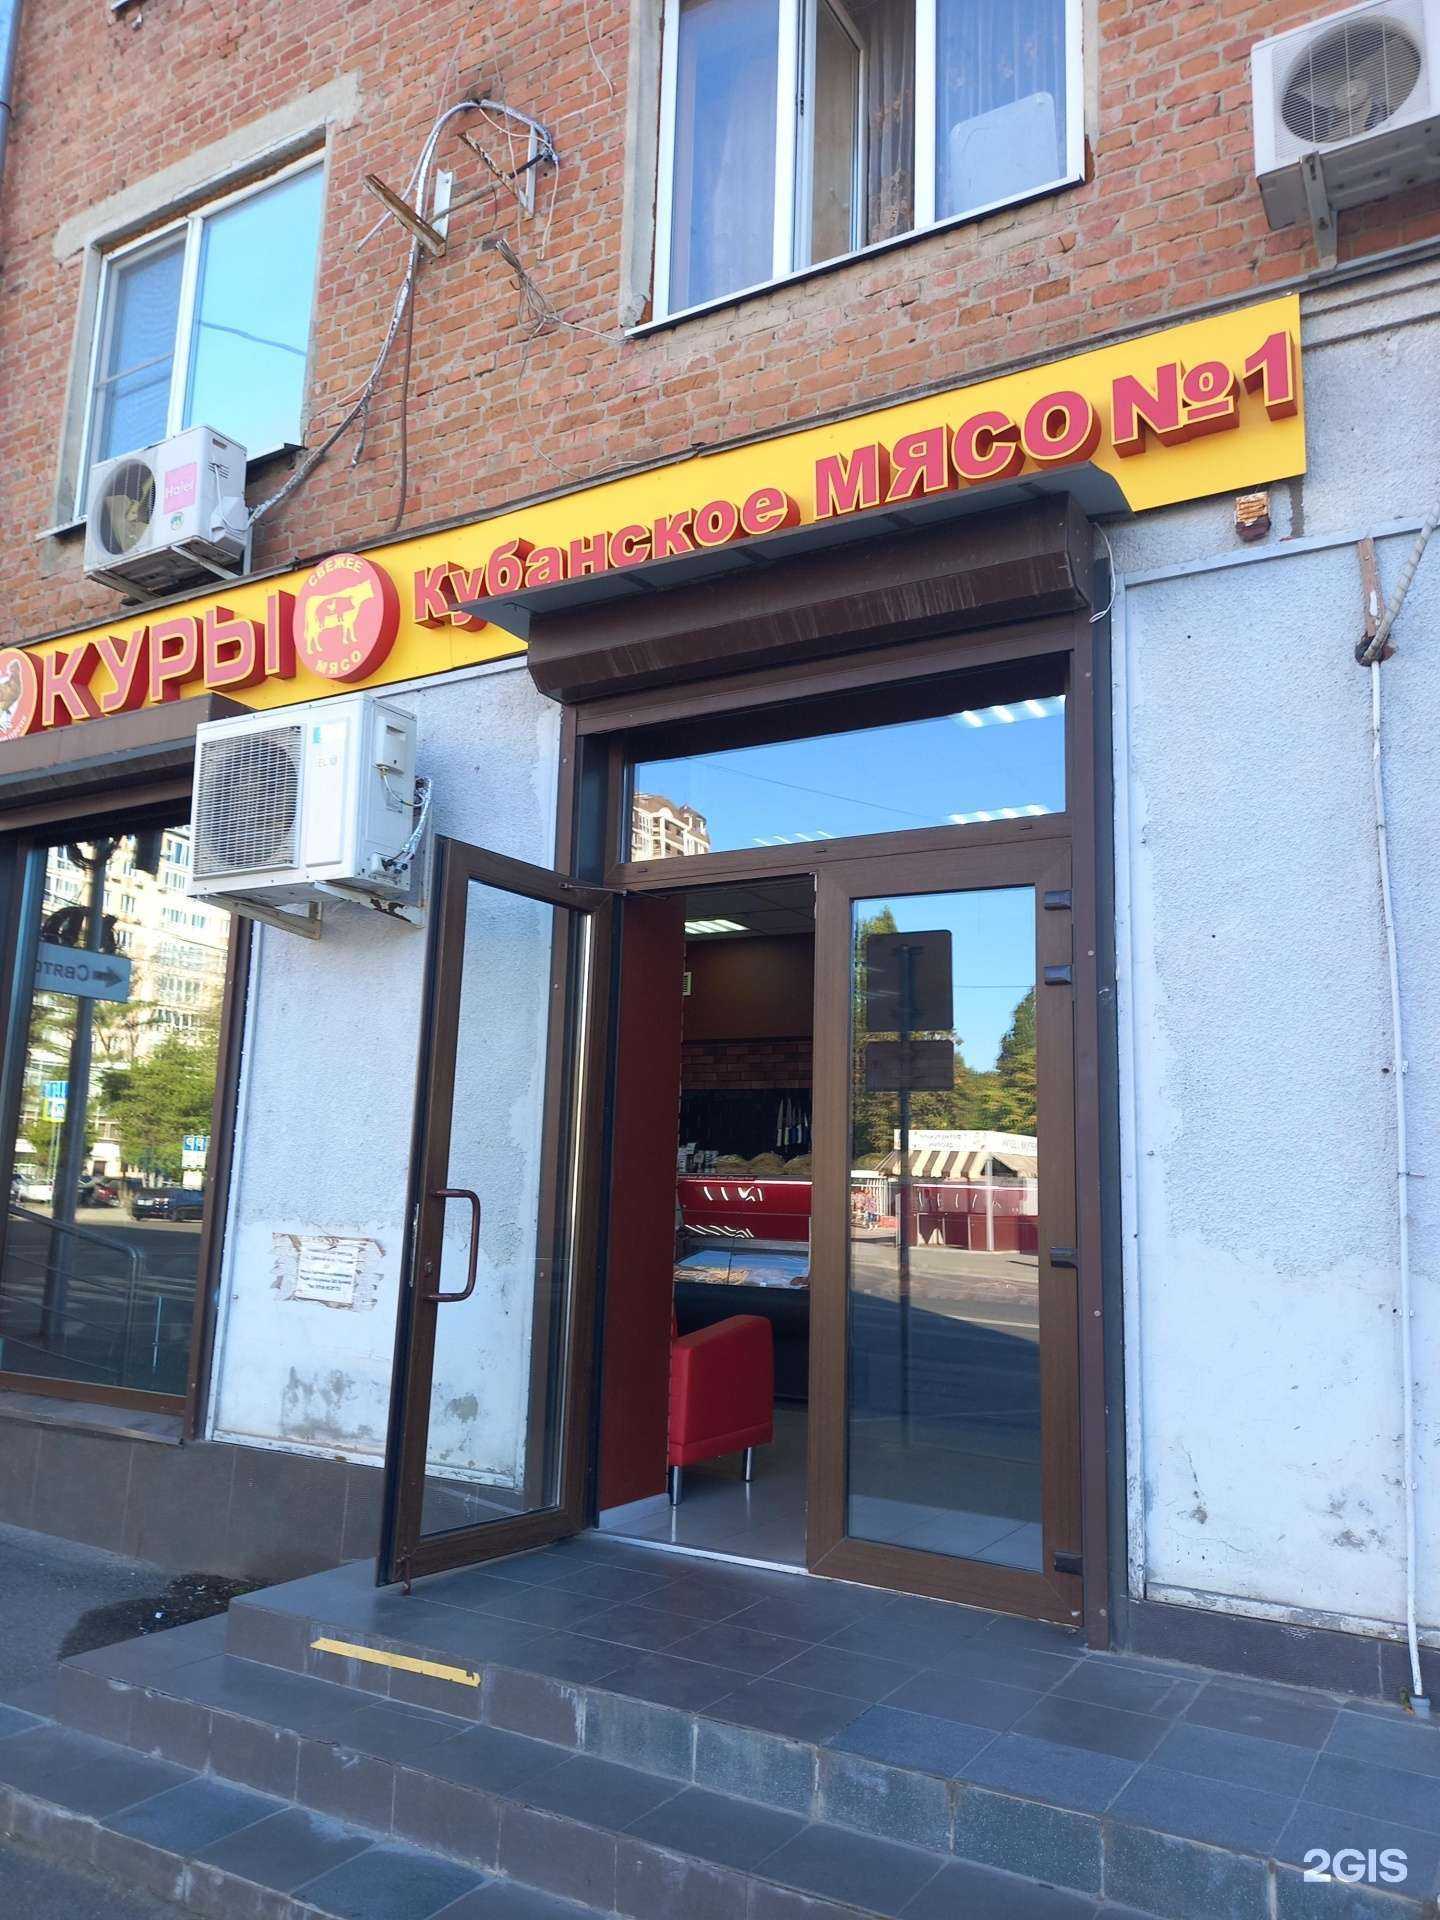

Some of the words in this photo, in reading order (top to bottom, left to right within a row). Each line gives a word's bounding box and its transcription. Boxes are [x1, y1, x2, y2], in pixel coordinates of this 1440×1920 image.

[414, 486, 793, 627] Кубанское
[1111, 330, 1295, 449] №1
[308, 556, 363, 587] СВЕЖЕЕ
[42, 590, 292, 727] КУРЫ
[314, 650, 362, 675] МЯСО
